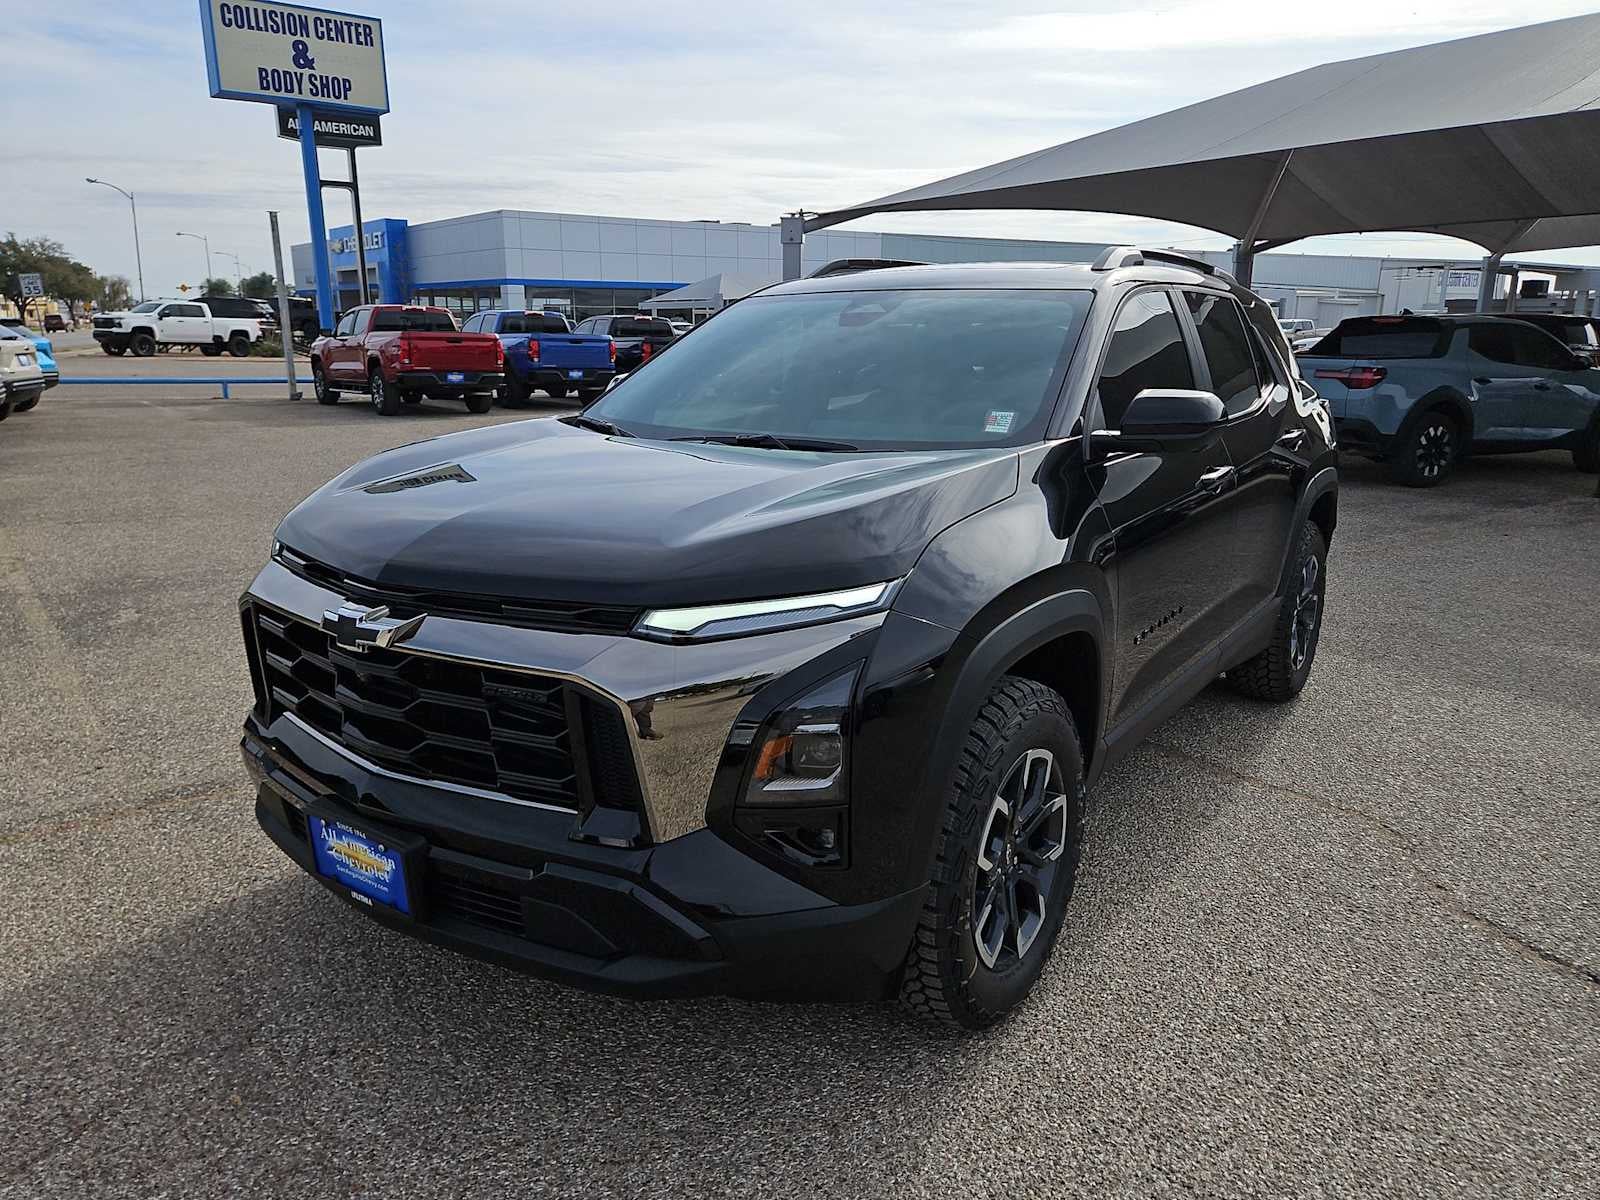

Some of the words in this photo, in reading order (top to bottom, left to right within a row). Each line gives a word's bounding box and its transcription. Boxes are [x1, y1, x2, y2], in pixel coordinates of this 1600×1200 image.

[220, 3, 310, 38] COLLISION
[313, 16, 374, 47] CENTER
[291, 39, 316, 70] &
[257, 67, 304, 95] BODY
[308, 73, 352, 101] SHOP
[288, 118, 303, 130] AL
[313, 120, 374, 137] AMERICAN
[344, 231, 385, 253] CHEOLET
[24, 286, 41, 295] 35
[320, 827, 337, 844] All
[342, 835, 396, 870] American
[331, 847, 389, 883] Chevrolet
